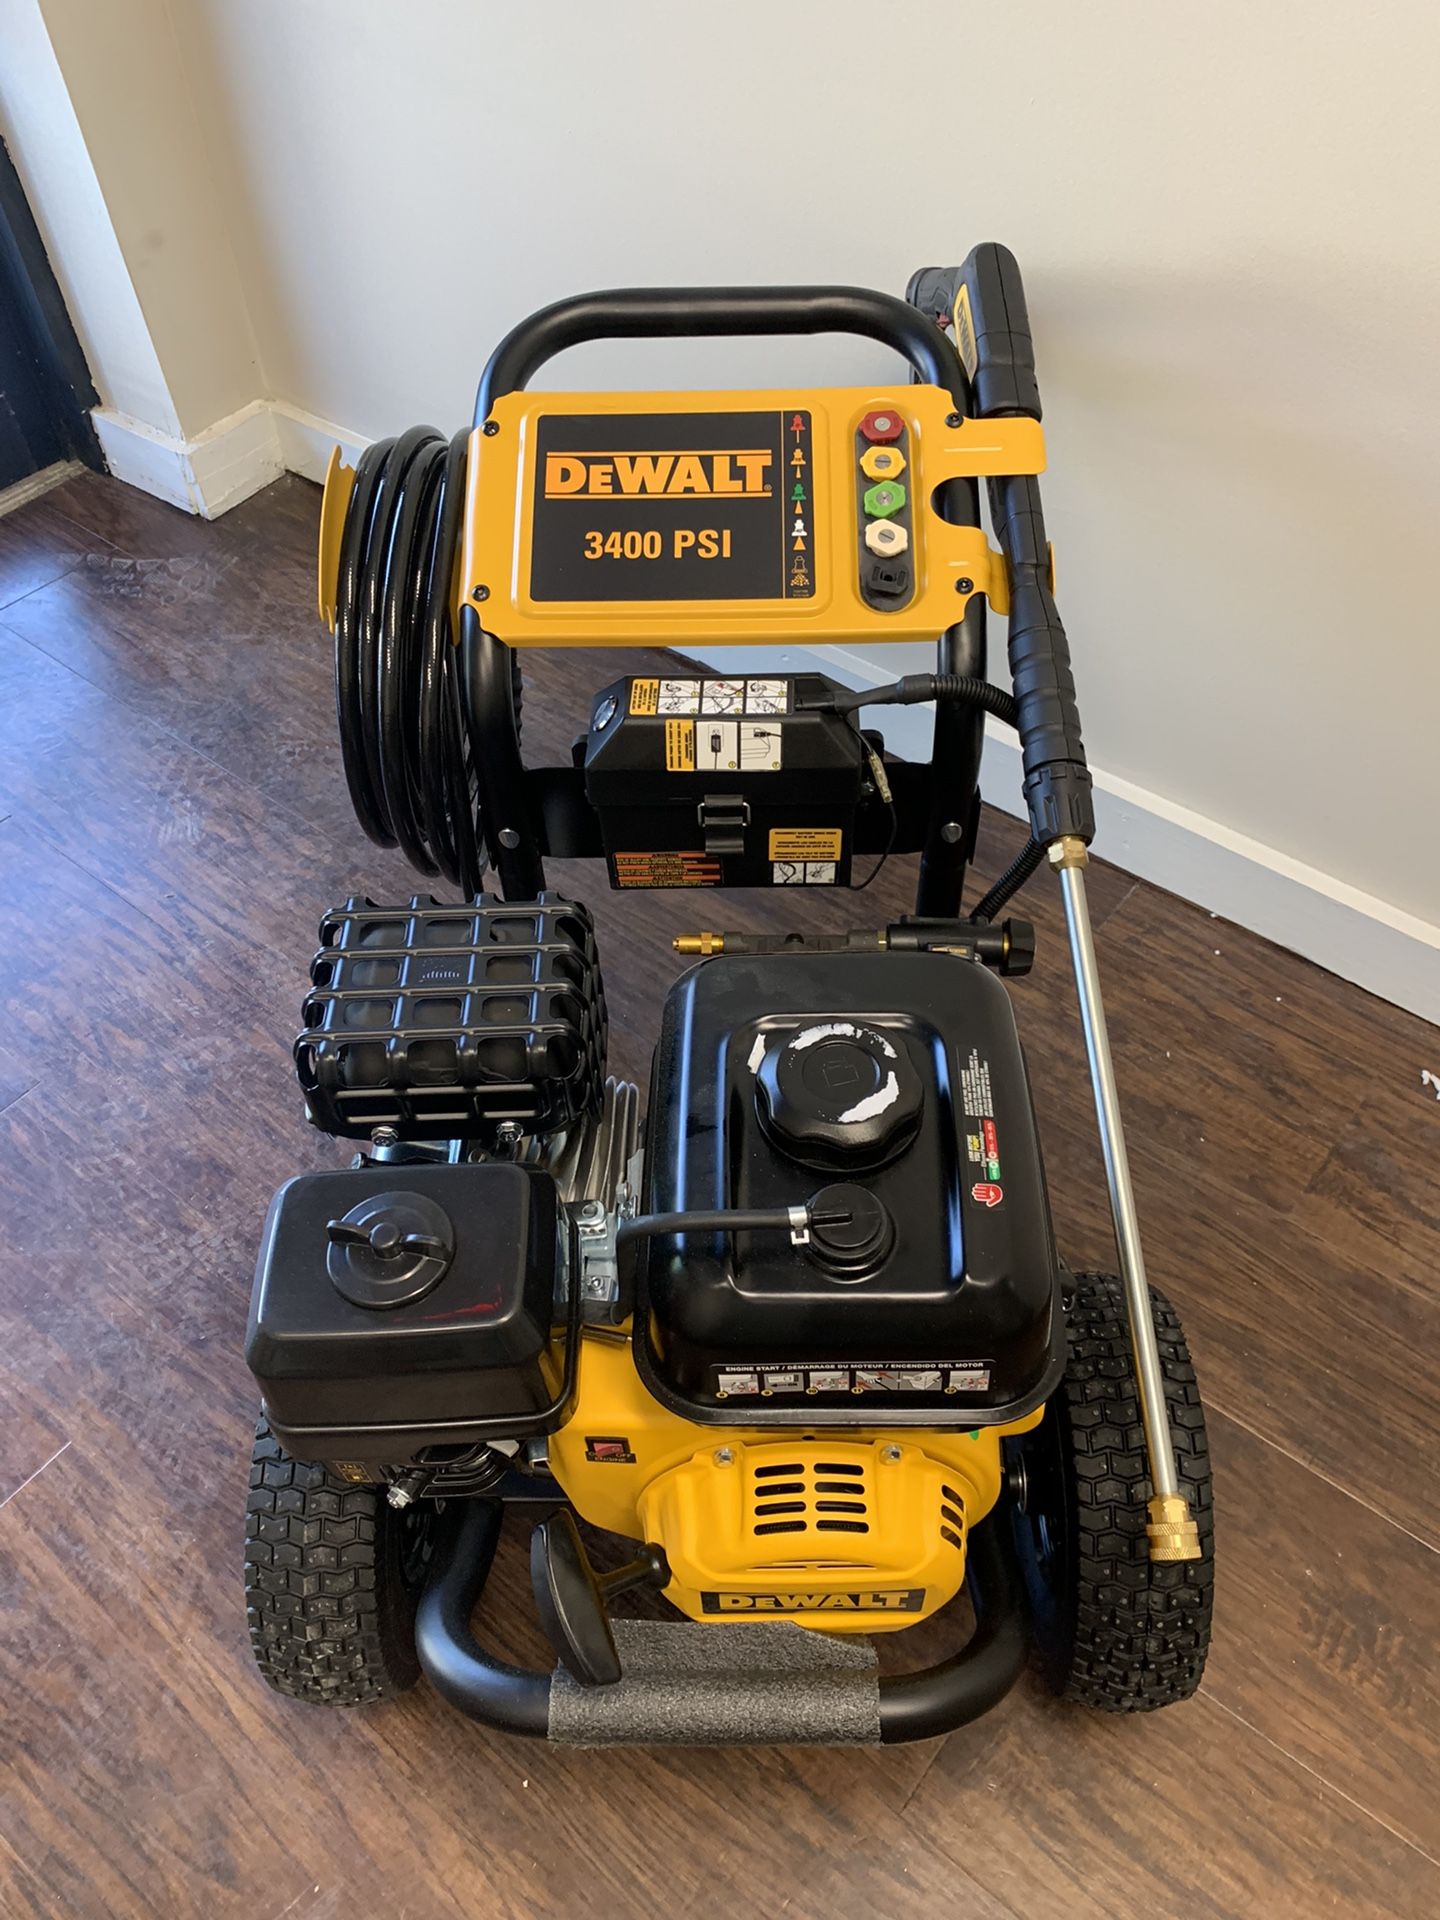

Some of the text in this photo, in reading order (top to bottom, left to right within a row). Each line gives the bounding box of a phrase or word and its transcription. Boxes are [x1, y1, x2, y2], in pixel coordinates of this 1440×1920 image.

[584, 529, 732, 560] 3400 PSI
[718, 1591, 909, 1609] DEWALT
